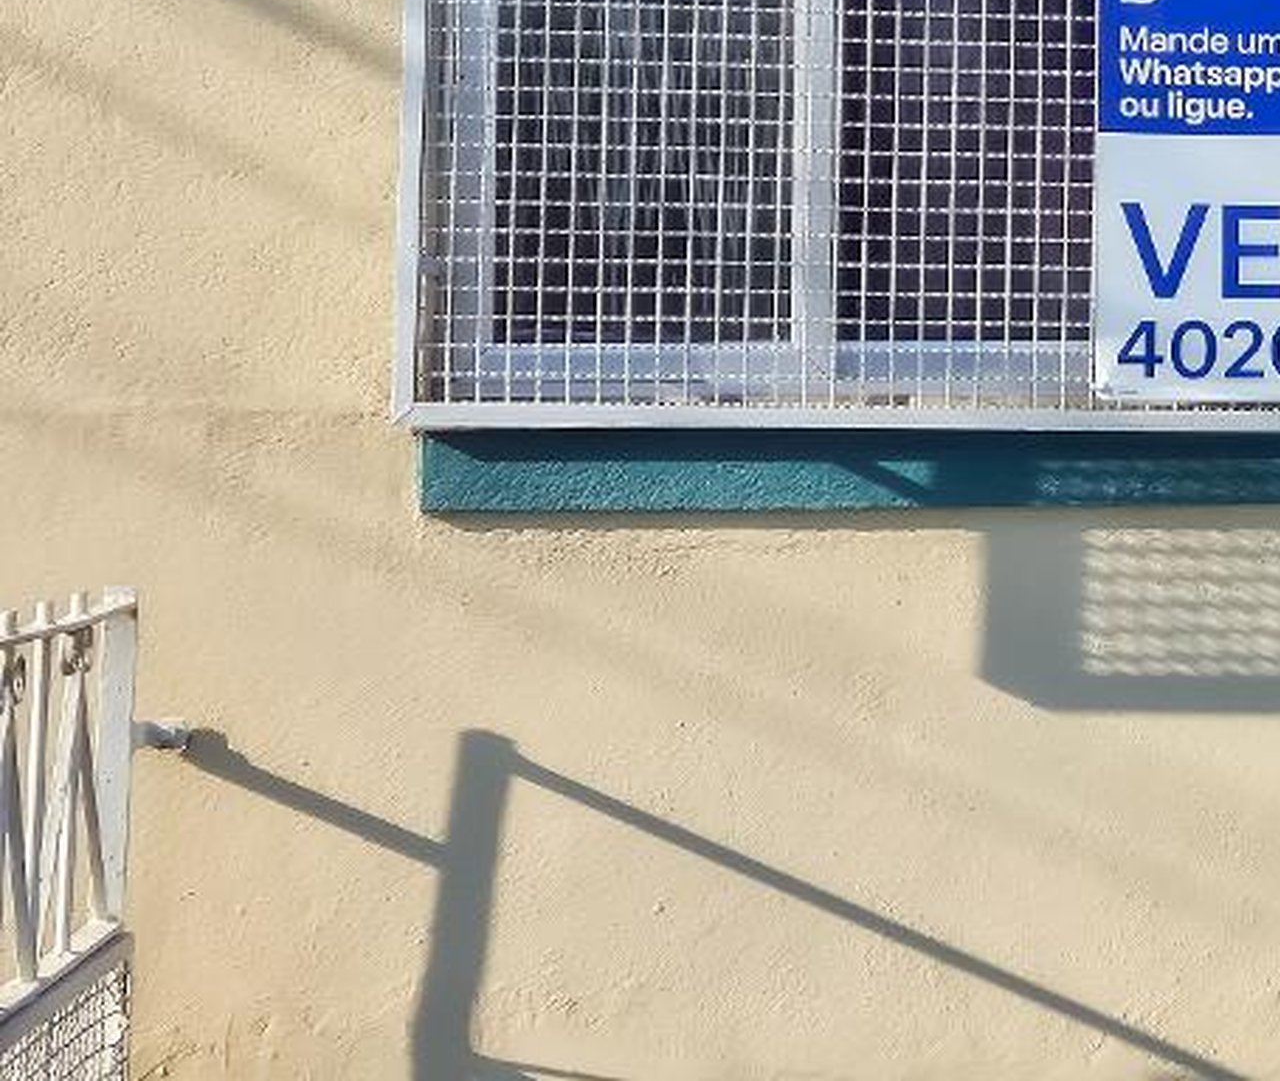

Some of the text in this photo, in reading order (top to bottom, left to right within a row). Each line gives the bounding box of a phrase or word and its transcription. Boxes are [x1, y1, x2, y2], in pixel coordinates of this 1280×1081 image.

[1119, 25, 1229, 54] Mande
[1119, 90, 1253, 125] ou ligue.
